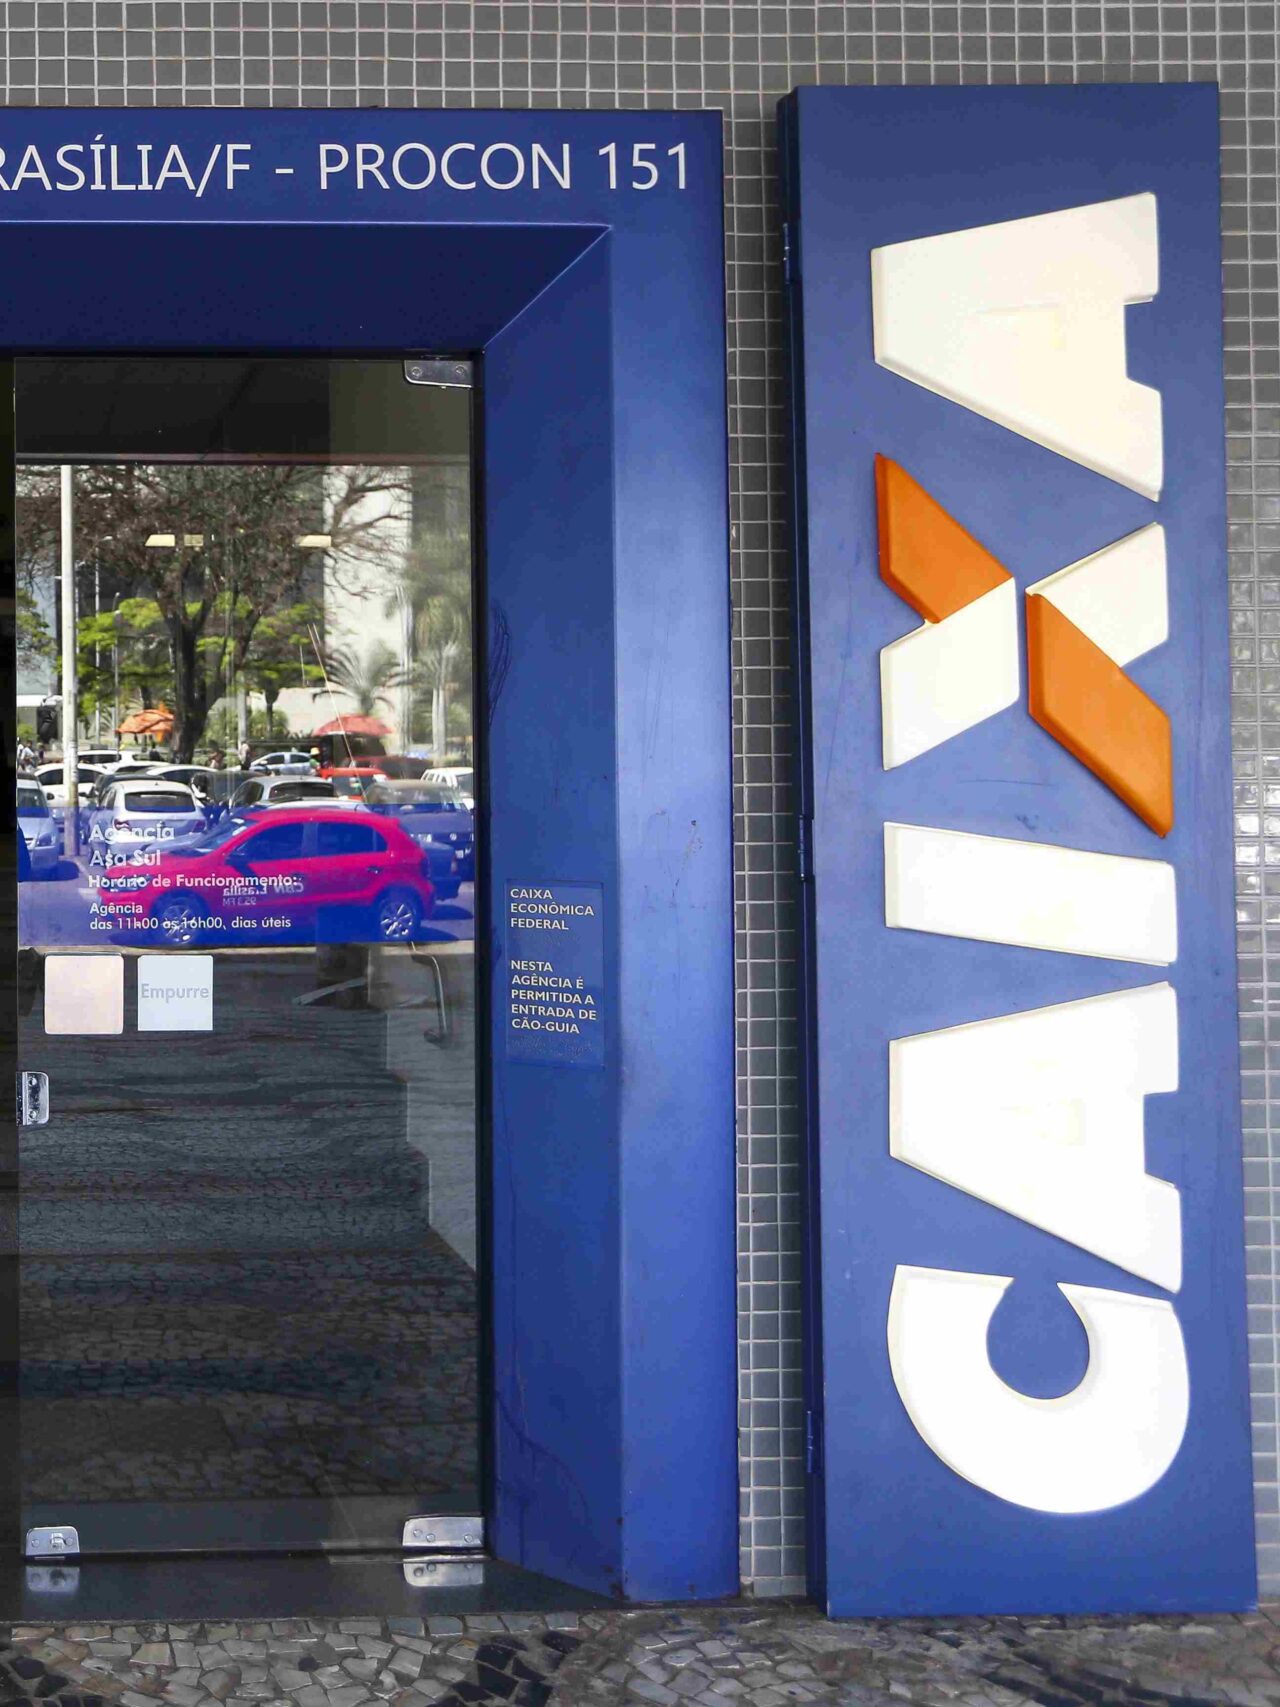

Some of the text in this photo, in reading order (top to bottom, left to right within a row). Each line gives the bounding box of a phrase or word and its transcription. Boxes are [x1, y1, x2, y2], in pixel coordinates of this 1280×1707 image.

[319, 142, 571, 191] PROCON
[597, 142, 690, 190] 151
[133, 849, 161, 867] Sul
[870, 192, 1190, 1515] CAIXA
[88, 873, 298, 888] Horário de Funcionamento:
[510, 888, 553, 900] CAIXA
[89, 902, 143, 917] Agência
[510, 902, 594, 916] ECONÔMICA
[89, 918, 113, 930] das
[117, 918, 159, 929] 11h00
[182, 917, 227, 930] 16h00,
[231, 917, 257, 928] dias
[261, 916, 292, 928] úteis
[510, 918, 569, 930] FEDERAL
[510, 960, 553, 972] NESTA
[511, 973, 584, 989] AGÊNCIA É
[140, 984, 209, 1002] Empurre
[511, 989, 595, 1005] PERMITIDA A
[511, 1003, 597, 1020] ENTRADA DE
[511, 1017, 580, 1034] CÃO-GUIA
